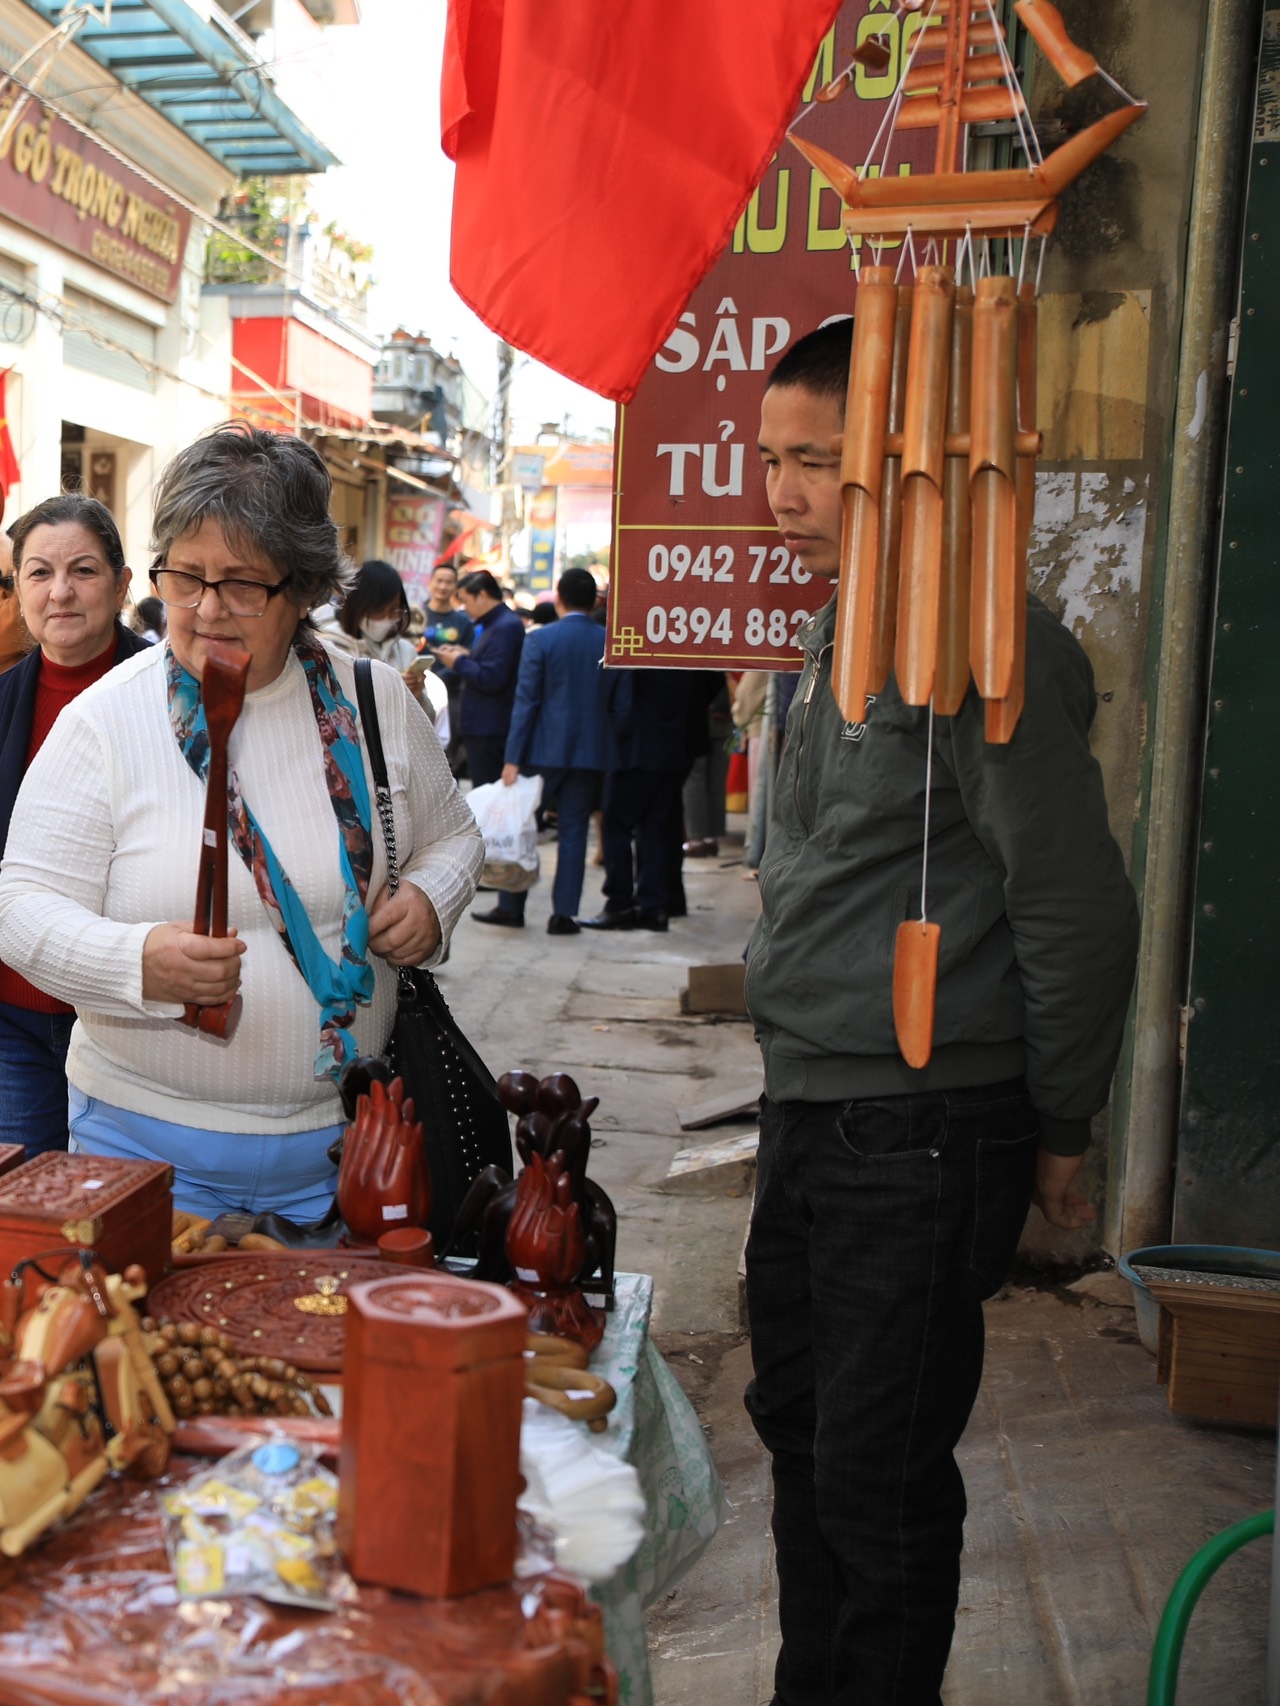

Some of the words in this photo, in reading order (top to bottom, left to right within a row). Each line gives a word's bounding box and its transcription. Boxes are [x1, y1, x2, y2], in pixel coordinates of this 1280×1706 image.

[51, 143, 125, 228] TRỌNG
[655, 297, 791, 393] SẬP
[656, 420, 745, 498] TỦ
[648, 544, 734, 582] 0942
[646, 605, 733, 645] 0394
